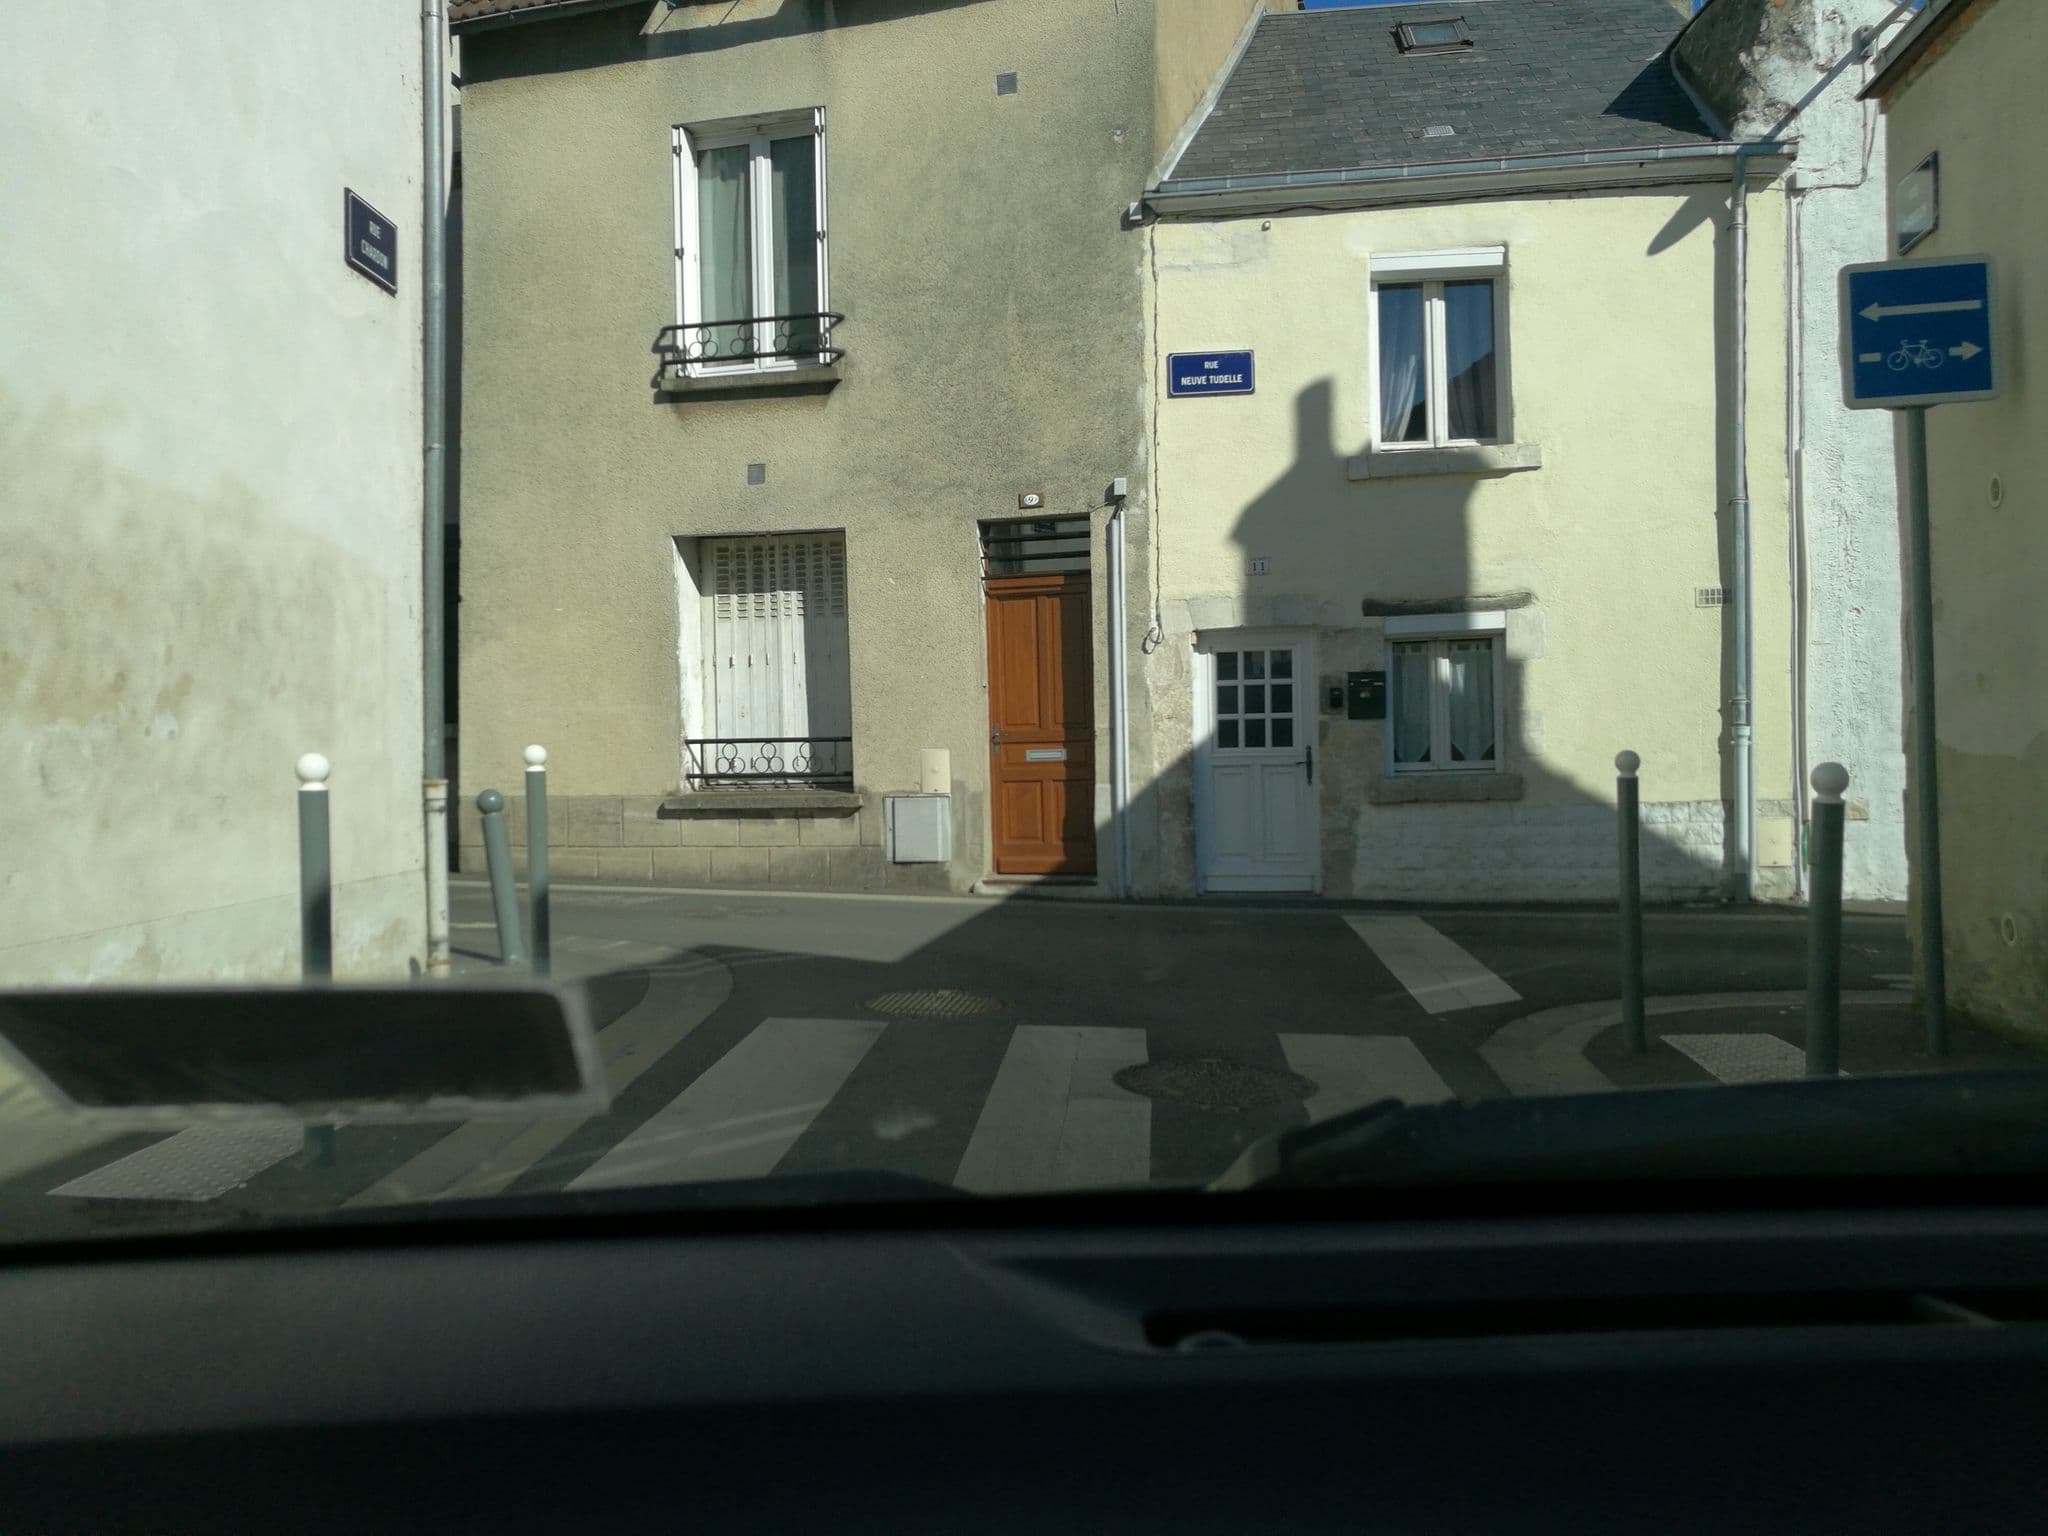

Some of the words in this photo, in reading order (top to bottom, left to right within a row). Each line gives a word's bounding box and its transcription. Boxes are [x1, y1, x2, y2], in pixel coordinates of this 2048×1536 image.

[369, 221, 380, 240] RUE
[1204, 361, 1219, 369] RUE
[1181, 376, 1207, 386] NEUVE
[1209, 374, 1243, 384] TUDELLE
